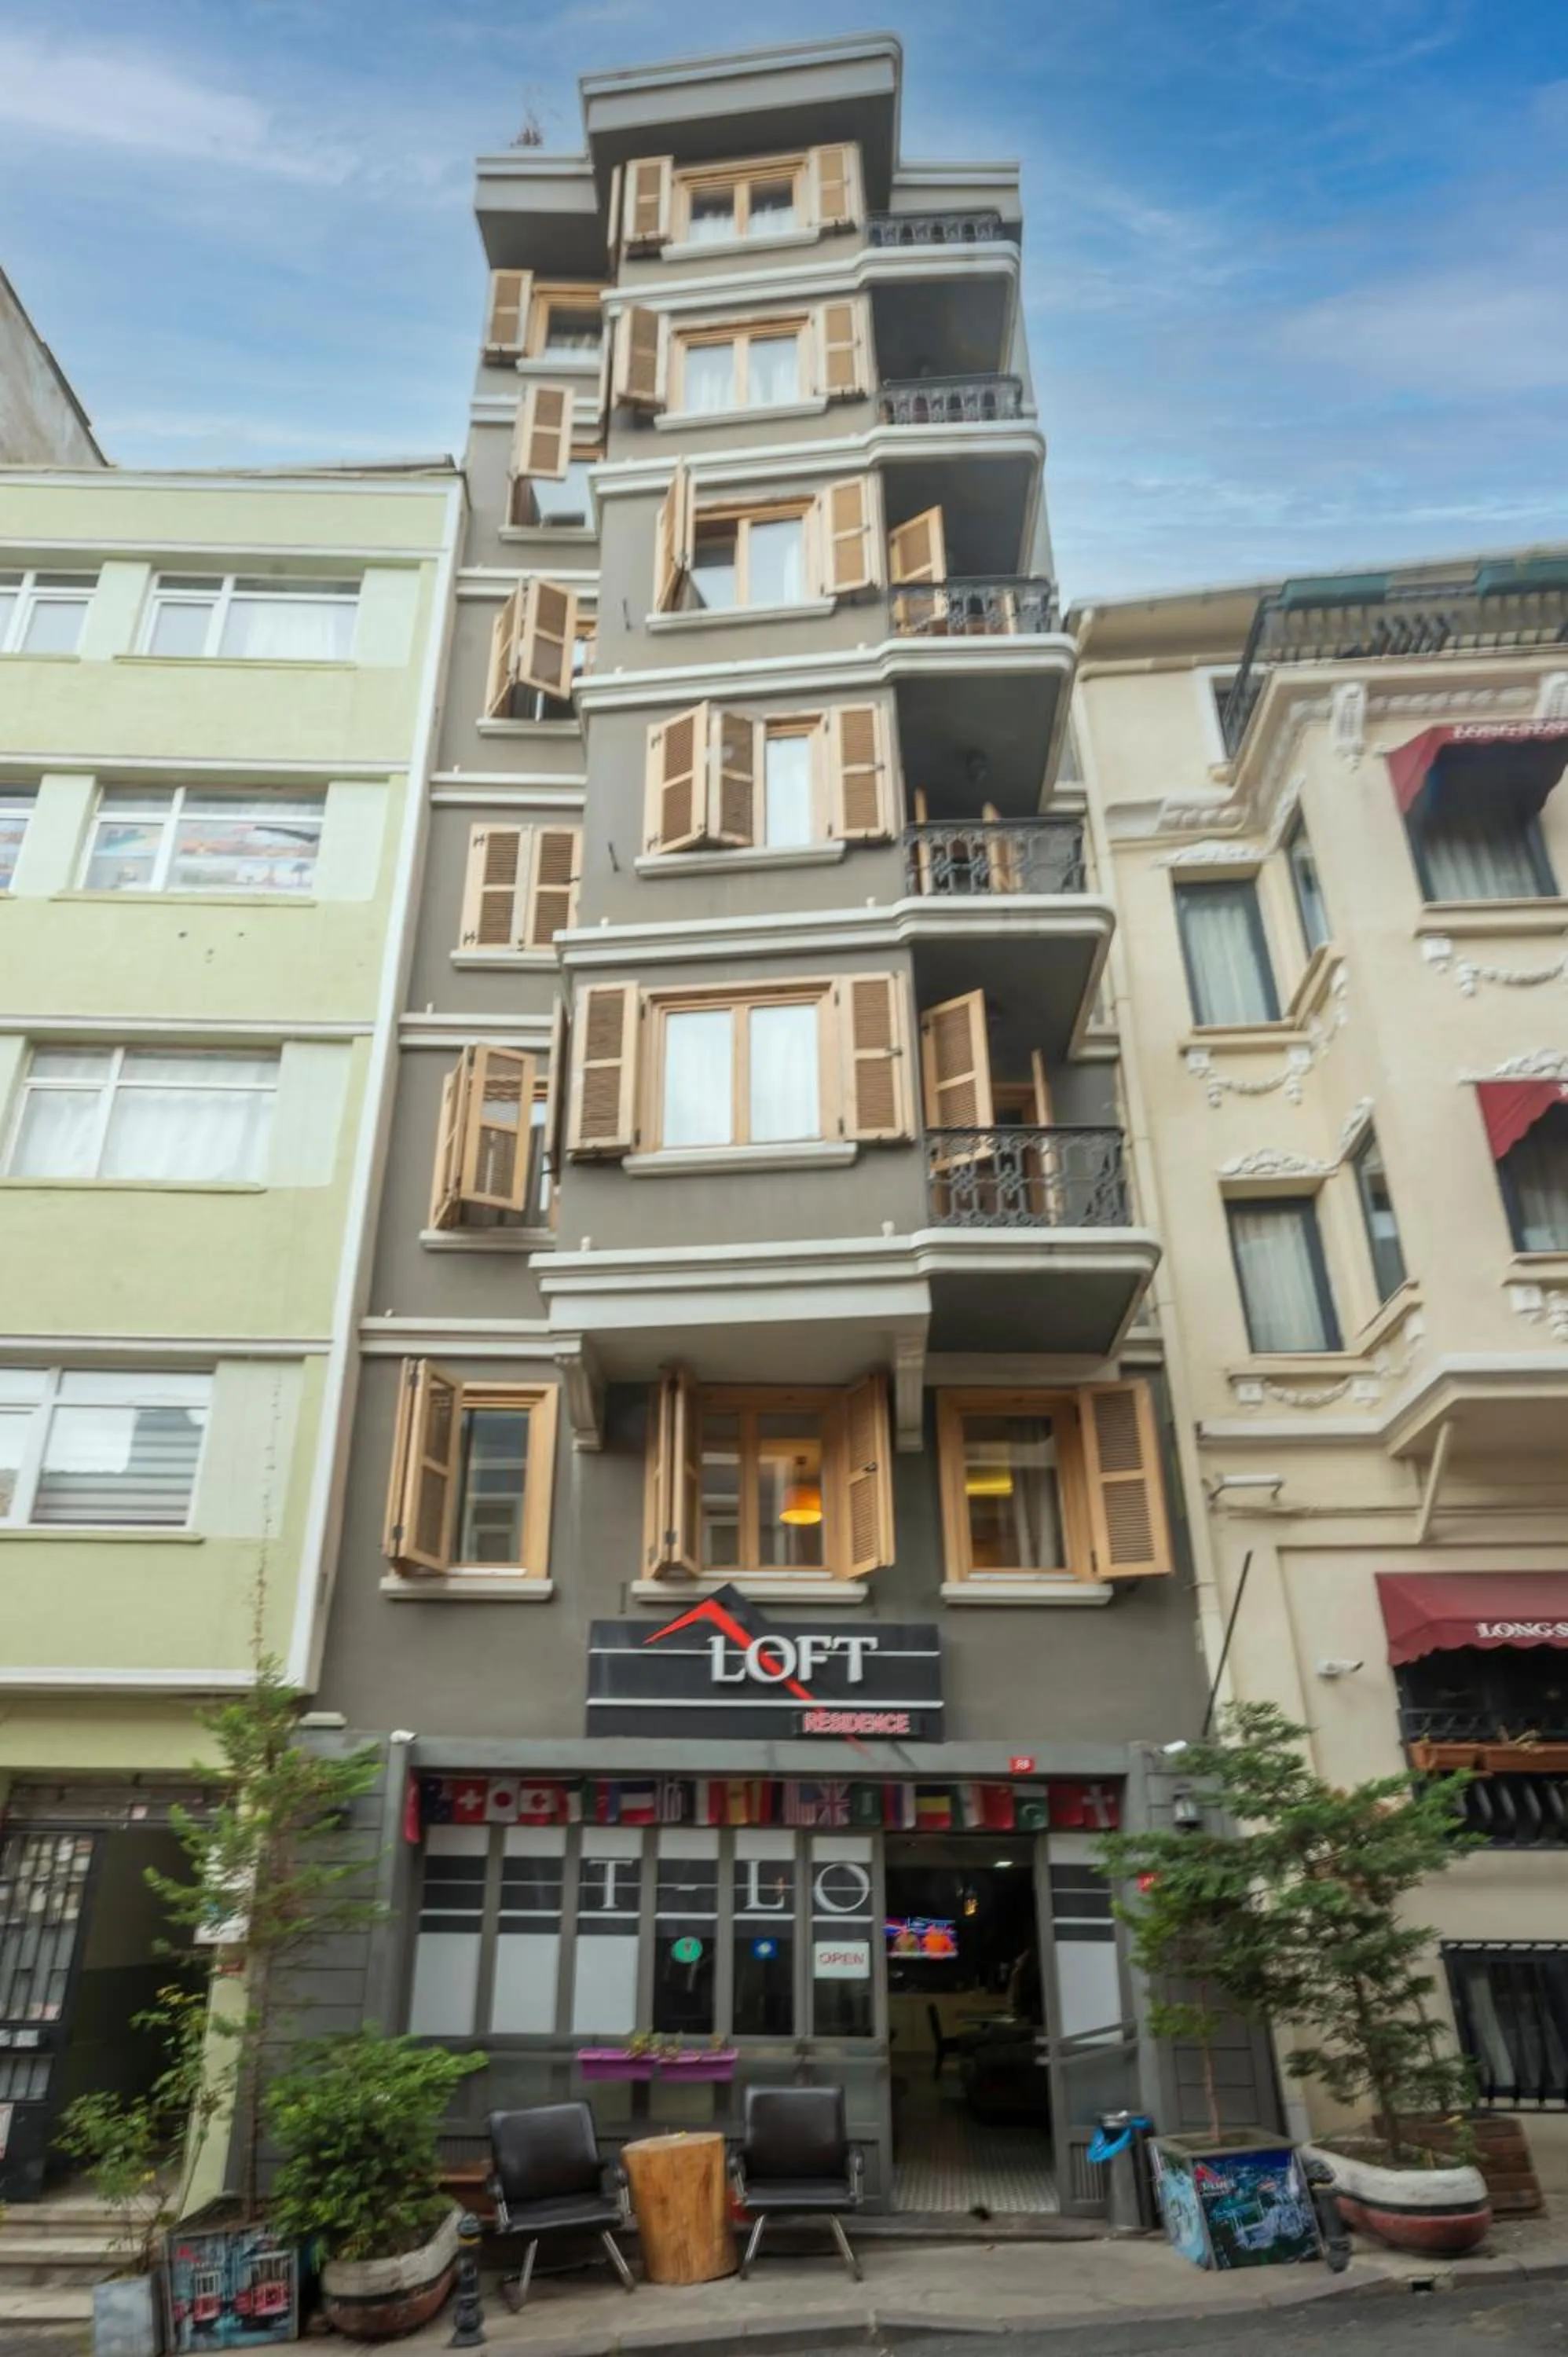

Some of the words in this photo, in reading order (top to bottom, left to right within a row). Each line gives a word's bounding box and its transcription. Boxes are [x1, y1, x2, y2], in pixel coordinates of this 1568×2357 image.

[707, 1635, 878, 1683] LOFT
[803, 1712, 910, 1734] RESIDENCE
[819, 1952, 865, 1965] OPEN
